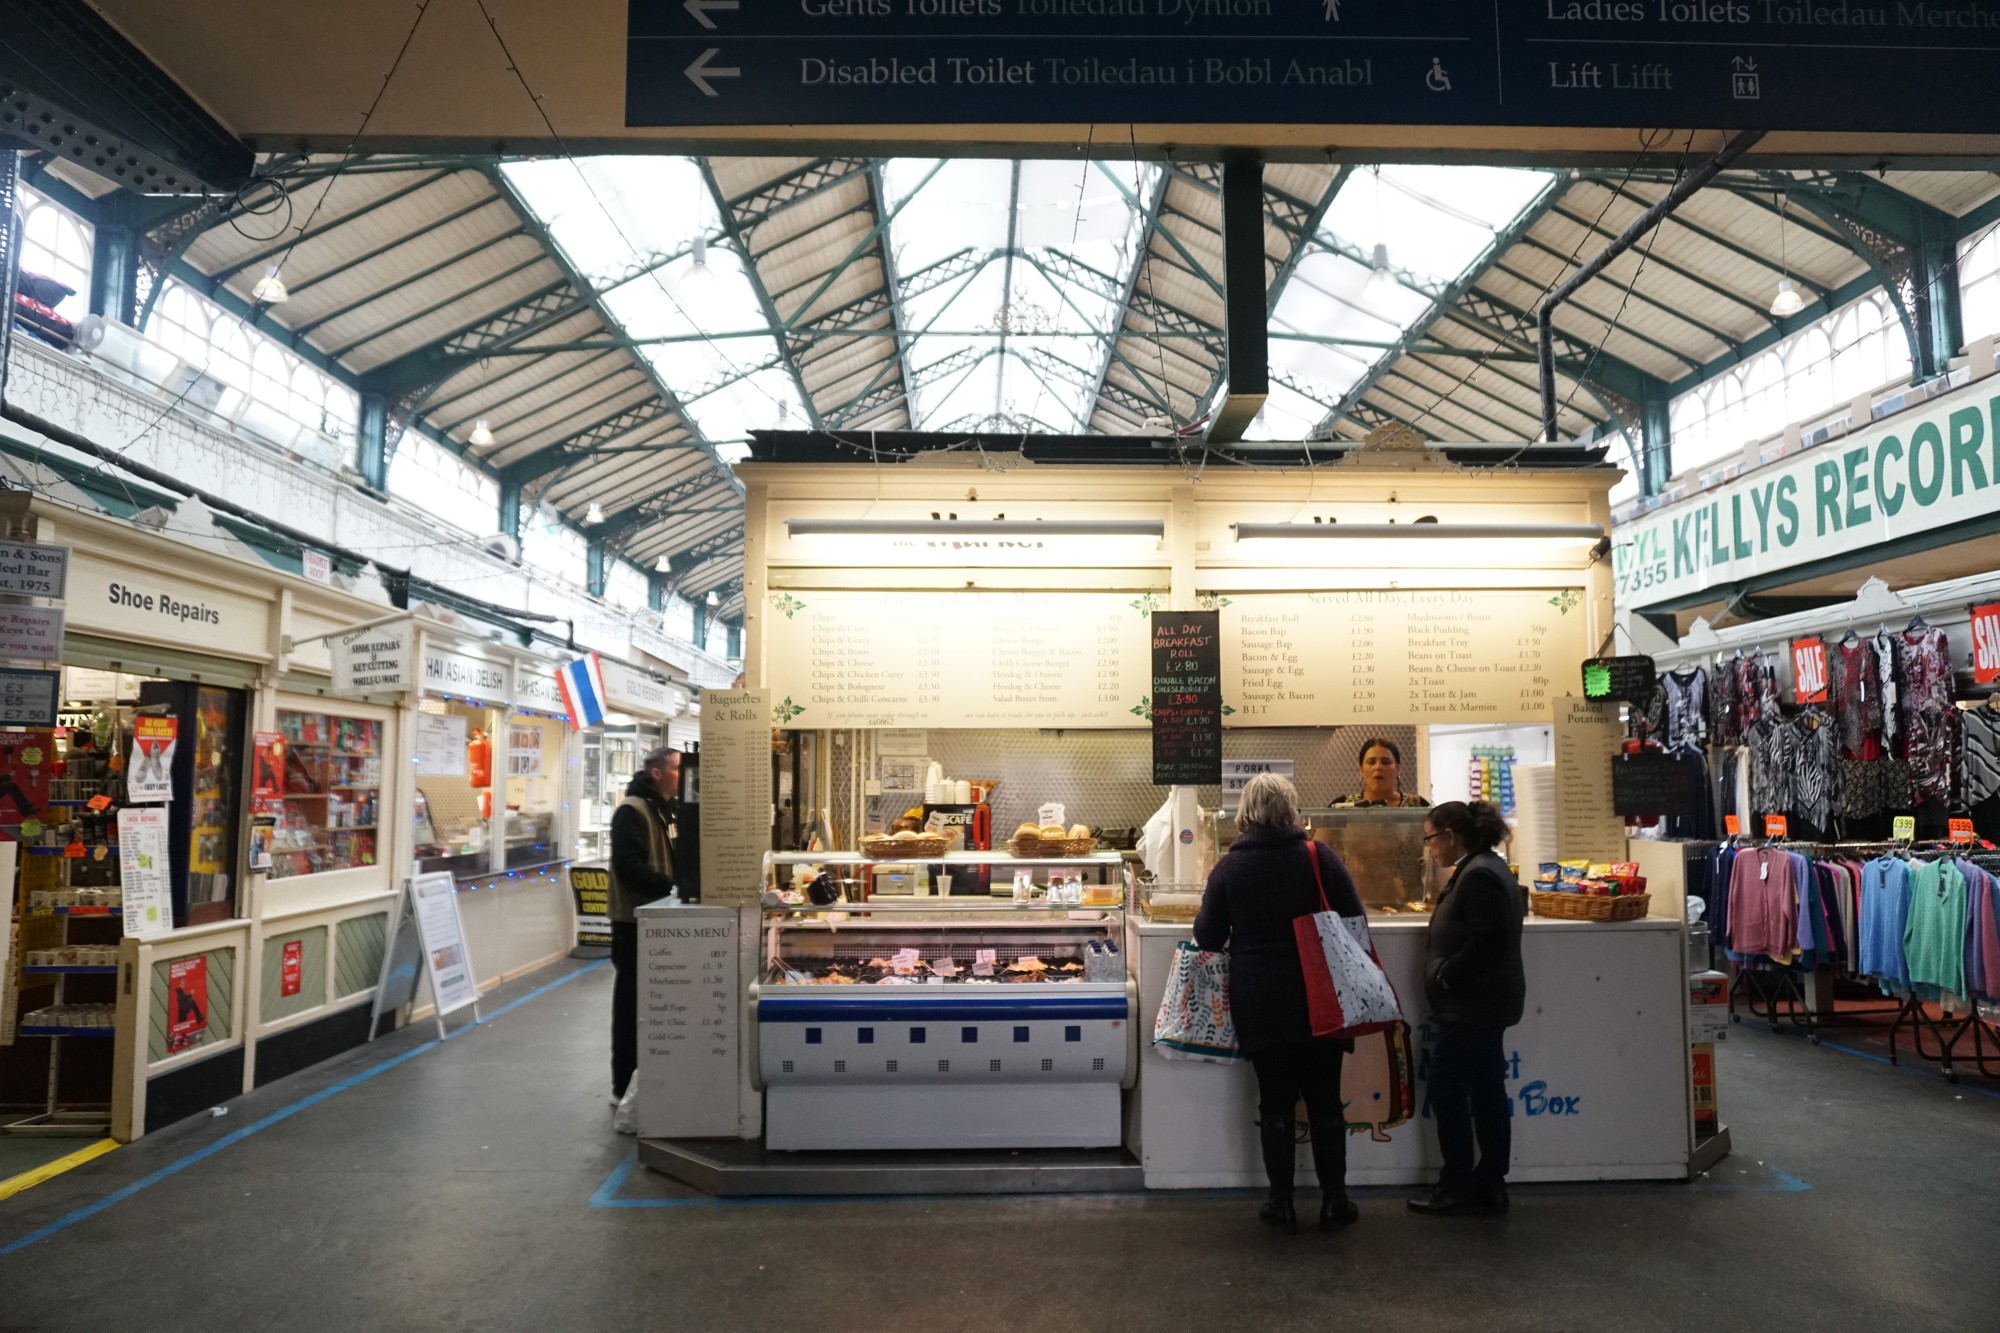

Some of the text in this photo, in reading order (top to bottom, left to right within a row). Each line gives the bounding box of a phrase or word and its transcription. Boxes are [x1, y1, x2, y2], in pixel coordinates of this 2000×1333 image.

[1896, 3, 2000, 28] Merche
[800, 57, 1374, 86] Disabled Toilet Toiledau i Bobl Anabl
[1548, 62, 1674, 91] Lift Lifft
[1672, 474, 1799, 580] KELLYS
[30, 550, 62, 563] Sons
[26, 565, 50, 577] Bar
[20, 580, 50, 592] 1975
[109, 583, 219, 624] Shoe Repairs
[11, 615, 50, 626] Repairs
[1242, 614, 1299, 623] Breakfast Roll
[1408, 612, 1492, 621] Mushrooms Beans
[26, 627, 45, 637] Cut
[812, 625, 835, 633] Chips
[1157, 624, 1203, 636] ALL DAY
[1242, 627, 1286, 638] Bacon Bap
[1408, 625, 1430, 634] Black
[1433, 625, 1470, 636] Pudding
[812, 637, 835, 645] Chips
[1153, 635, 1212, 650] BREAKFAST
[1242, 640, 1273, 651] Sausage
[1276, 640, 1292, 650] Bap
[1408, 638, 1469, 648] Breakfast Tray
[8, 642, 54, 653] you wait
[352, 641, 400, 654] SHOE REPAIRS
[812, 648, 835, 656] Chips
[1170, 649, 1196, 659] ROLL
[1242, 653, 1268, 661] Bacon
[1282, 652, 1298, 664] Egg
[1408, 651, 1432, 660] Beans
[1449, 651, 1472, 660] Toast
[353, 660, 398, 672] KEY CUTTING
[812, 660, 835, 668] Chips
[1045, 660, 1070, 668] Burger
[1408, 664, 1433, 673] Beans
[1436, 664, 1443, 673] &
[1447, 664, 1477, 673] Cheese
[1492, 664, 1516, 672] Toast
[1796, 645, 1825, 693] SALE
[446, 662, 472, 684] ASIAN
[476, 669, 502, 690] DELISH
[812, 671, 835, 679] Chips
[882, 671, 904, 680] Curry
[1242, 665, 1274, 677] Sausage
[1288, 666, 1304, 676] Egg
[1188, 676, 1216, 685] BACON
[1242, 678, 1264, 687] Fried
[1267, 678, 1283, 689] Egg
[1409, 676, 1549, 687] 2x Toast 80p
[5, 683, 24, 693] £3
[812, 683, 885, 692] Chips Bolognese
[709, 694, 761, 707] Baguettes
[812, 696, 835, 704] Chips
[993, 695, 1013, 703] Salad
[1038, 694, 1057, 703] from
[1242, 691, 1274, 702] Sausage
[1278, 692, 1285, 700] &
[1289, 691, 1315, 700] Bacon
[1409, 690, 1544, 700] 2x Toast & Jam £1.00
[1353, 705, 1374, 713] £2.10
[1409, 702, 1545, 712] 2x Toast & Marmite £1.00
[1572, 703, 1603, 713] Baked
[3, 710, 45, 721] £7.50
[714, 710, 757, 721] & Rolls
[1567, 714, 1609, 724] Potatoes
[572, 872, 608, 889] GOLD
[645, 928, 731, 939] DRINKS MENU
[648, 949, 672, 957] Coffee
[648, 1004, 668, 1012] Small
[648, 1048, 671, 1056] Water
[1520, 1080, 1581, 1117] Box
